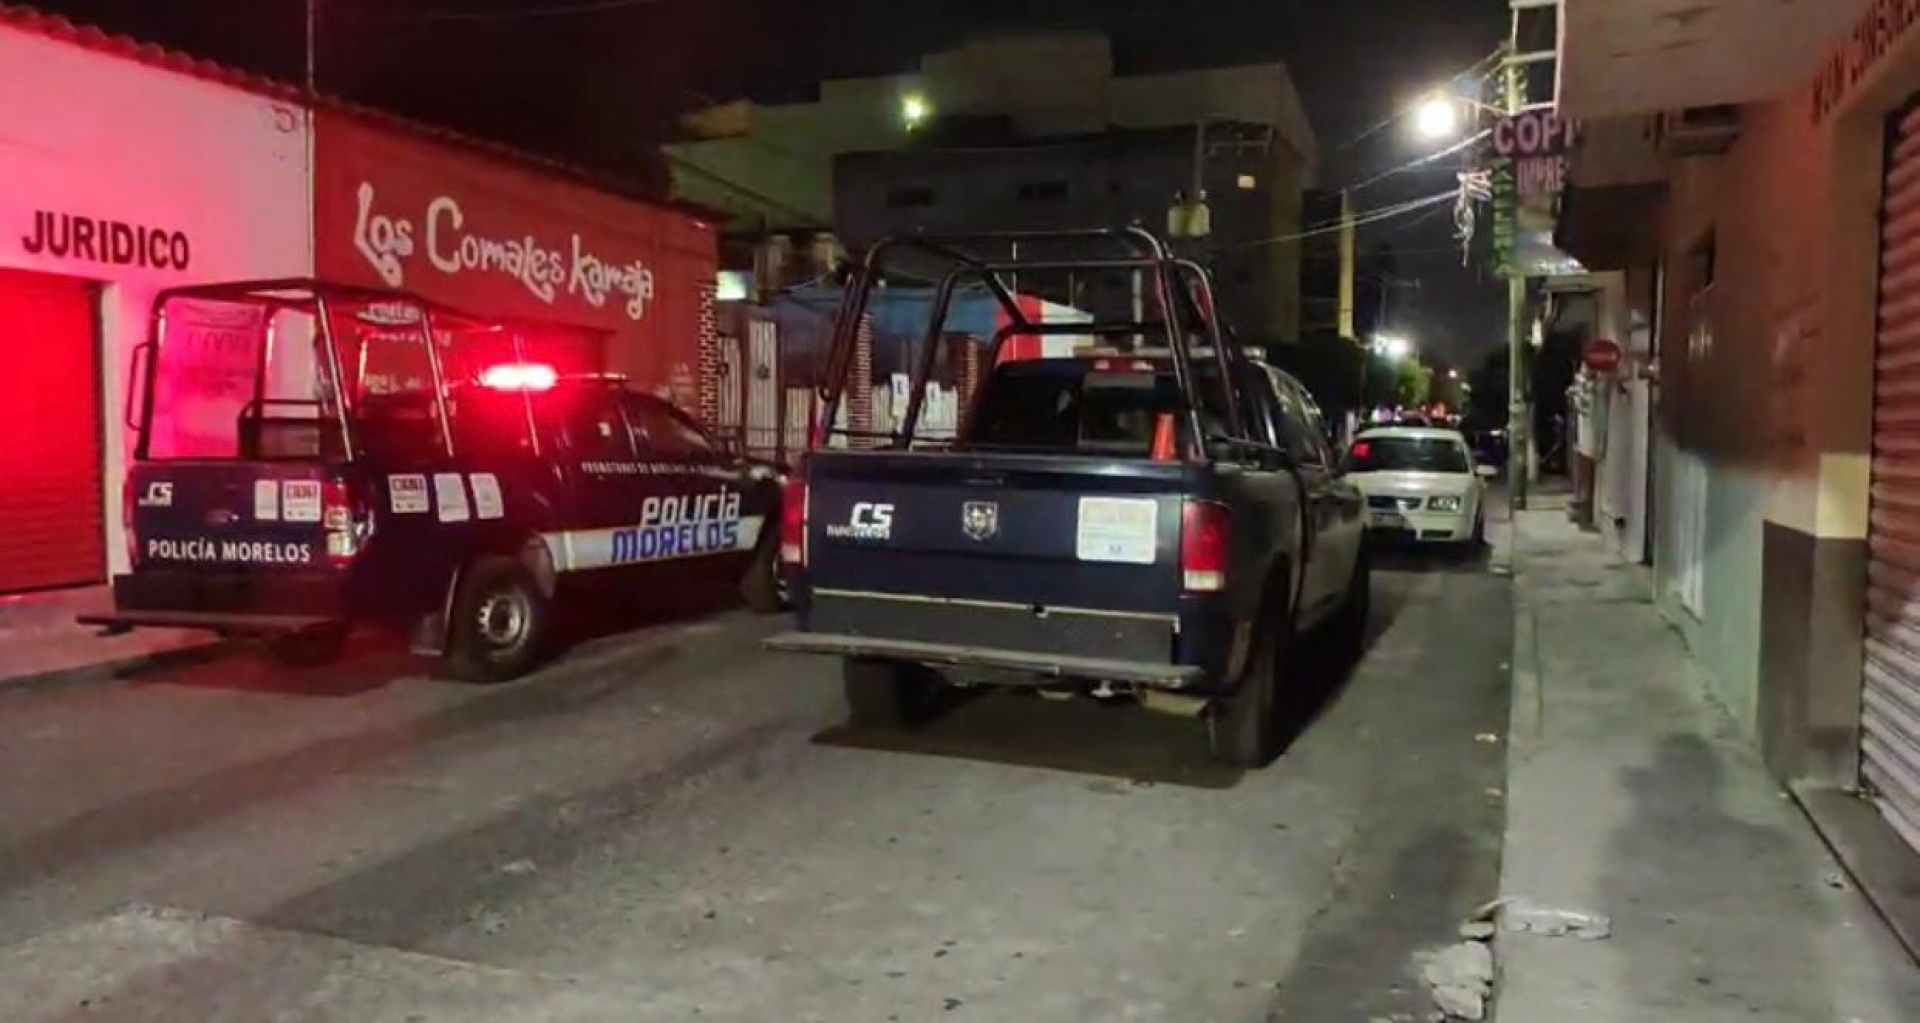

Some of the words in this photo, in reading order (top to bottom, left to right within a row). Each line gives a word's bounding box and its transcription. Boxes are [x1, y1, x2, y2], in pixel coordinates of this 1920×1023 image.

[1494, 113, 1581, 154] COPI
[22, 210, 190, 271] JURIDICO
[353, 182, 414, 288] Los
[426, 196, 567, 304] Comales
[221, 541, 311, 563] MORELOS
[611, 520, 739, 563] MORELOS
